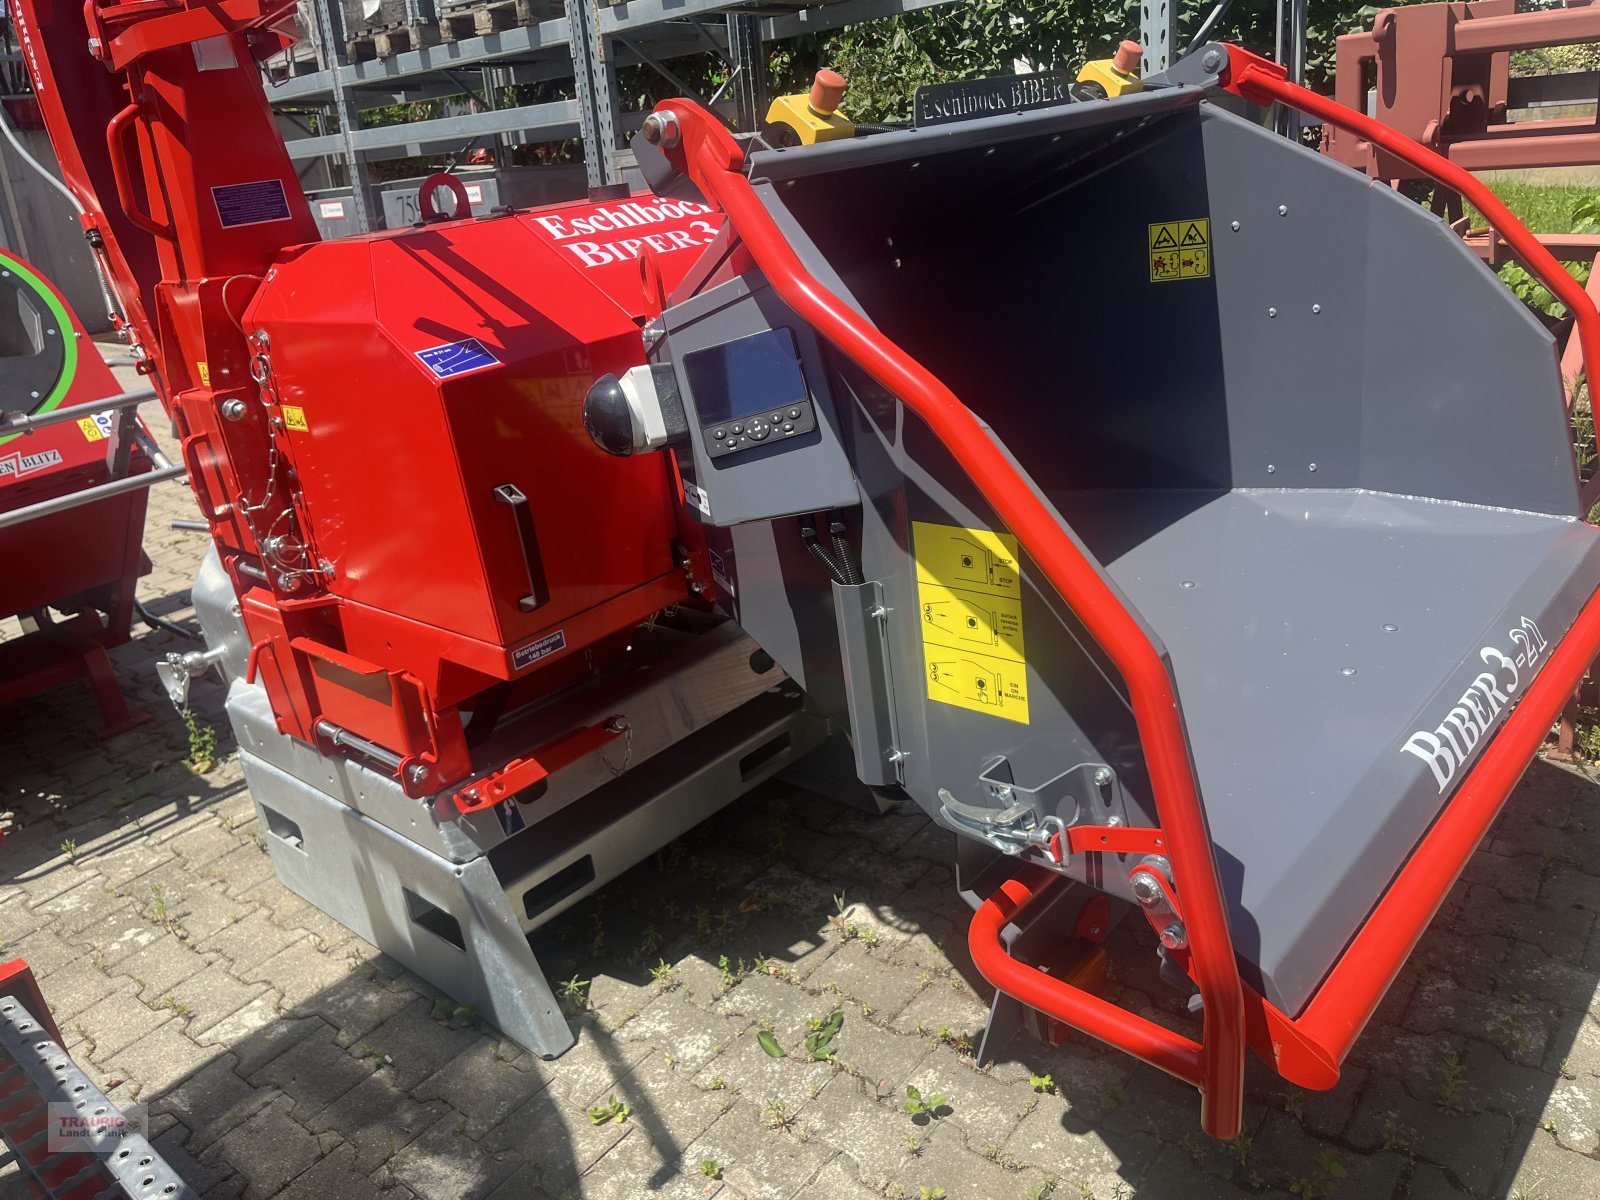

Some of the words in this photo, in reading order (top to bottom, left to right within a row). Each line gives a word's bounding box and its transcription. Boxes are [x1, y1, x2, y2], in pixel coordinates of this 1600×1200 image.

[1011, 76, 1064, 107] BIBER
[22, 451, 60, 468] BLITZ
[515, 633, 561, 659] Betriebsdruck
[528, 651, 540, 660] 140
[541, 646, 552, 655] bar
[1004, 692, 1026, 701] MARCHE
